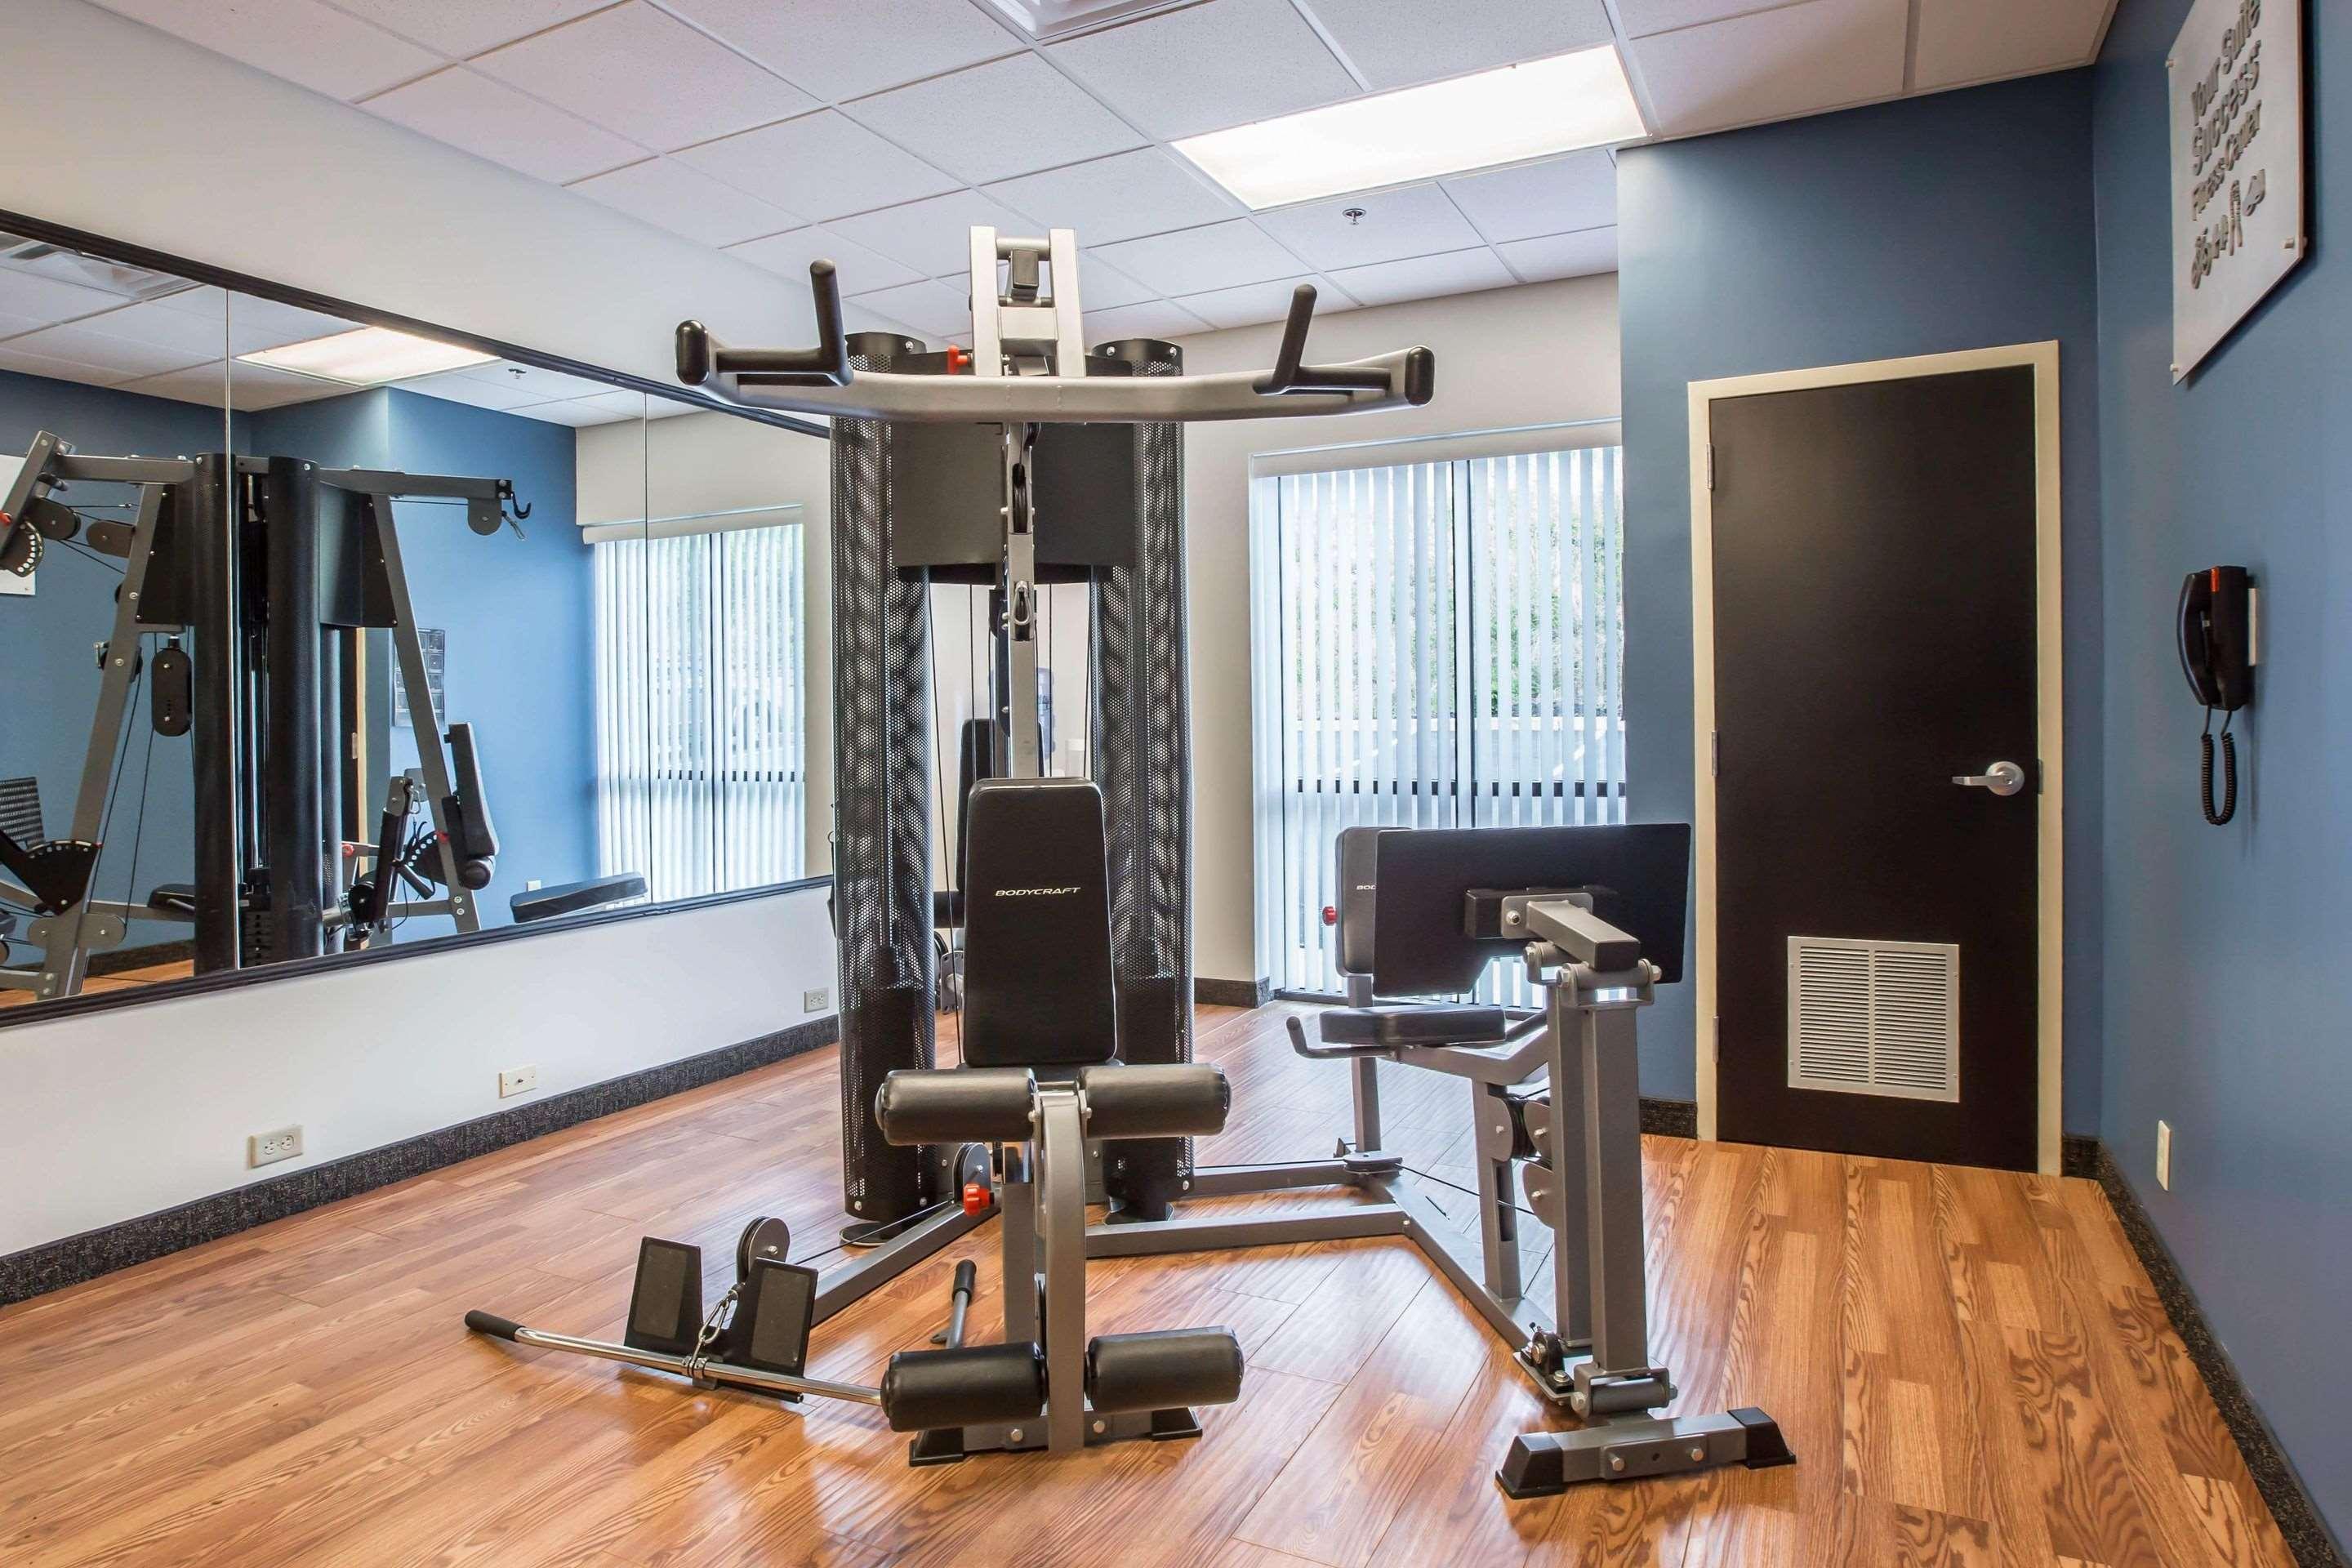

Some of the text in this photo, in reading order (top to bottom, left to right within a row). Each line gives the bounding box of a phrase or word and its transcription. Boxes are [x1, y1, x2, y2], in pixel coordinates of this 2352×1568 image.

[2191, 0, 2261, 126] Your Suite
[2192, 40, 2261, 176] Success
[996, 887, 1081, 897] BODYCRAFT
